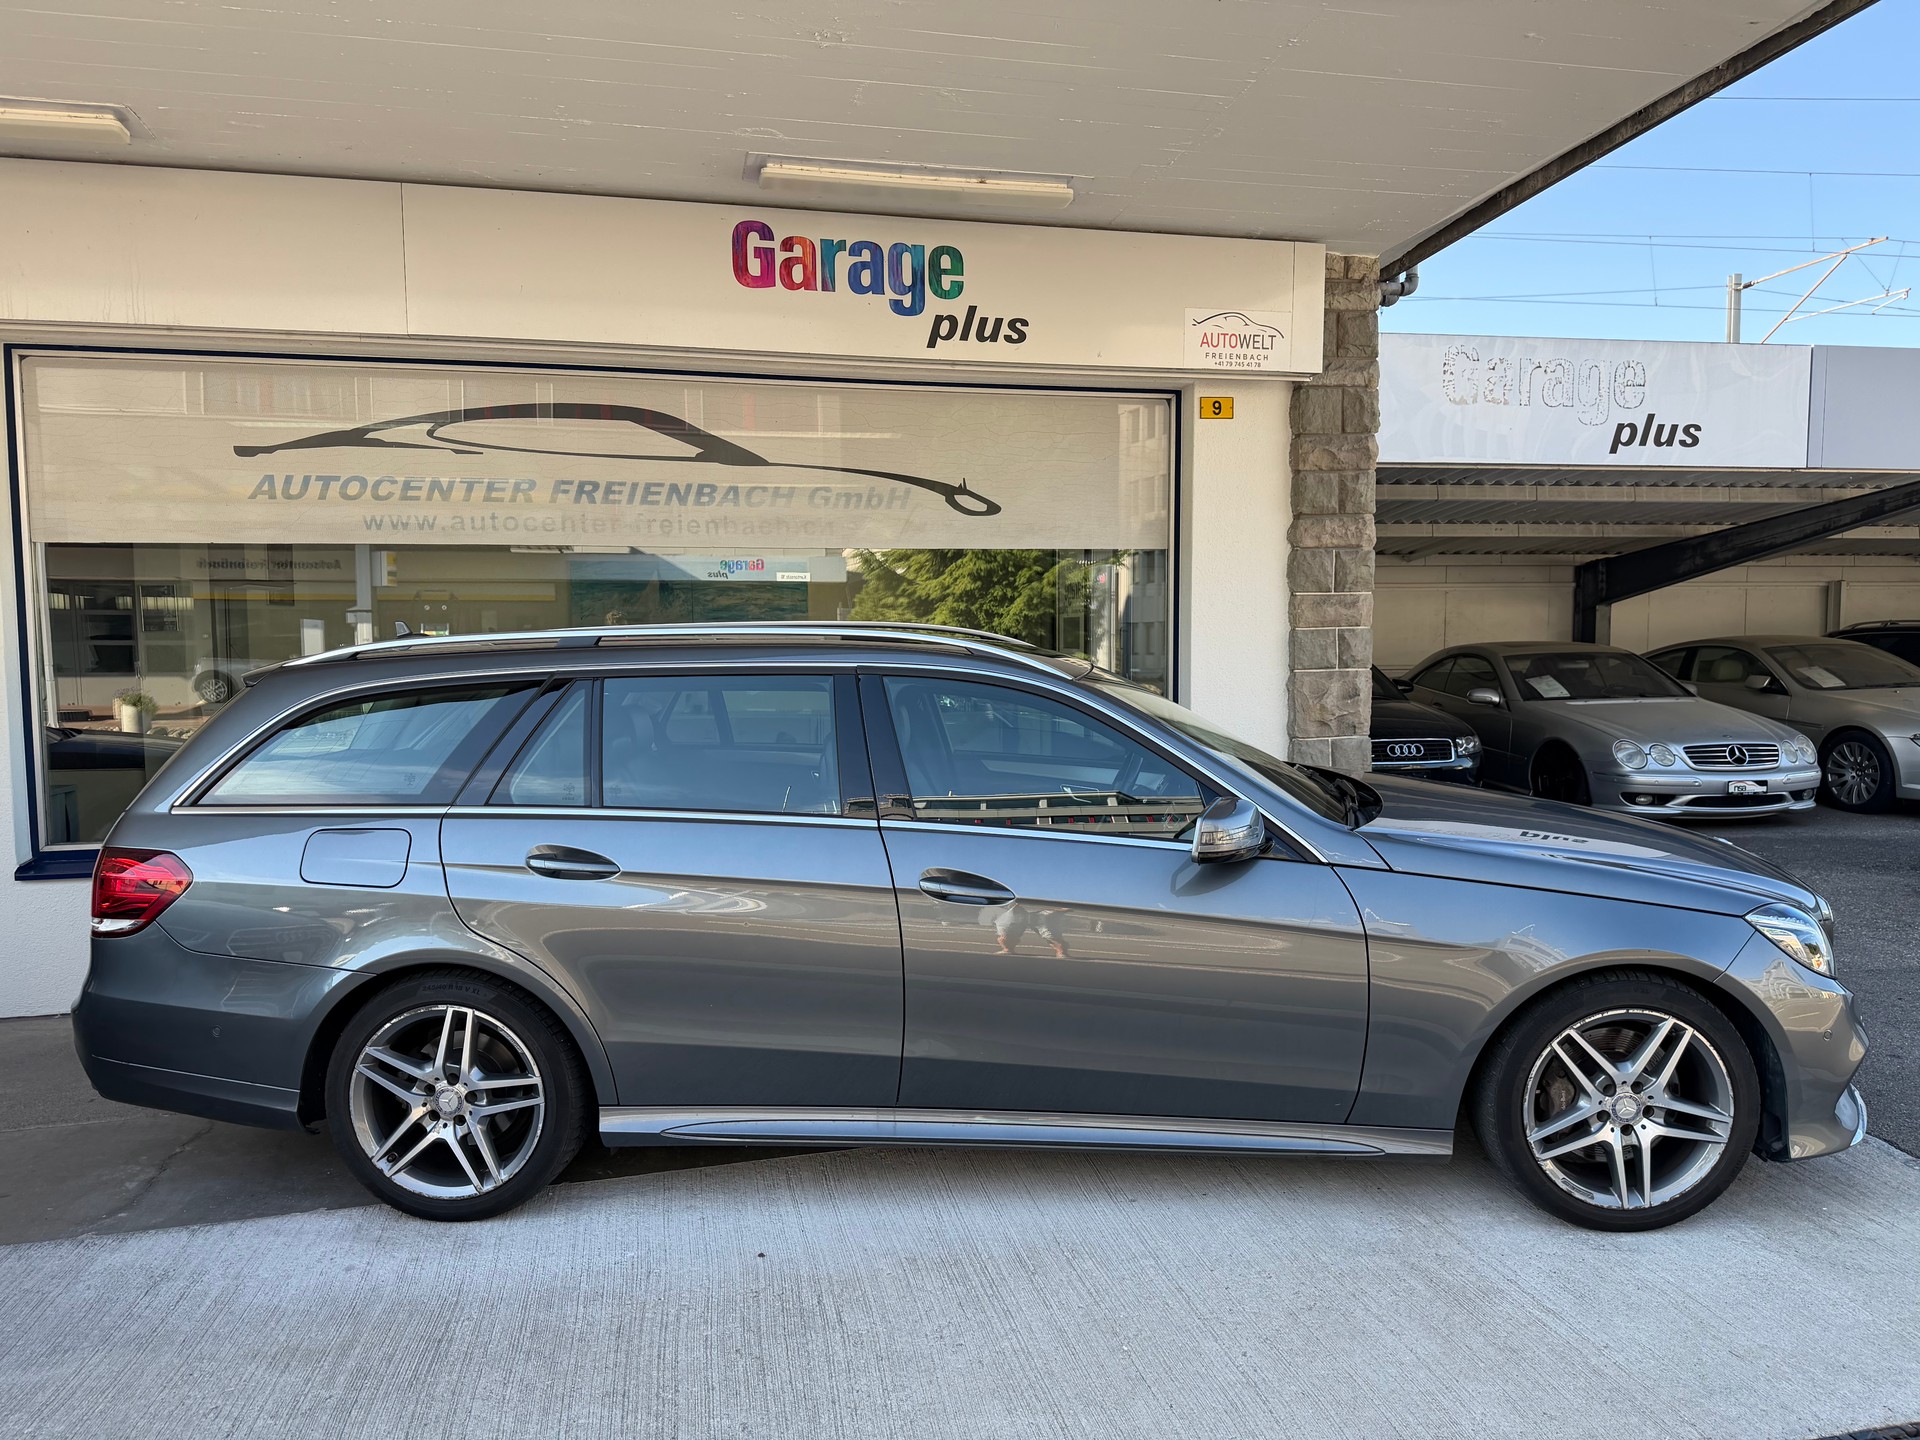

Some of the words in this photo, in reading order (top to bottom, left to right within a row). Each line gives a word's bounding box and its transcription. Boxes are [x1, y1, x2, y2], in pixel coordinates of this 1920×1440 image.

[731, 219, 965, 317] Garage
[926, 305, 1029, 348] plus
[1199, 332, 1277, 350] AUTOWELT
[1205, 352, 1269, 361] FREIENBACH
[1442, 344, 1646, 426] Garage
[1212, 400, 1222, 416] 9
[1608, 413, 1702, 455] plus
[247, 473, 537, 504] AUTOCENTER
[549, 479, 798, 508] FREIENBACH
[807, 485, 912, 511] GmbH
